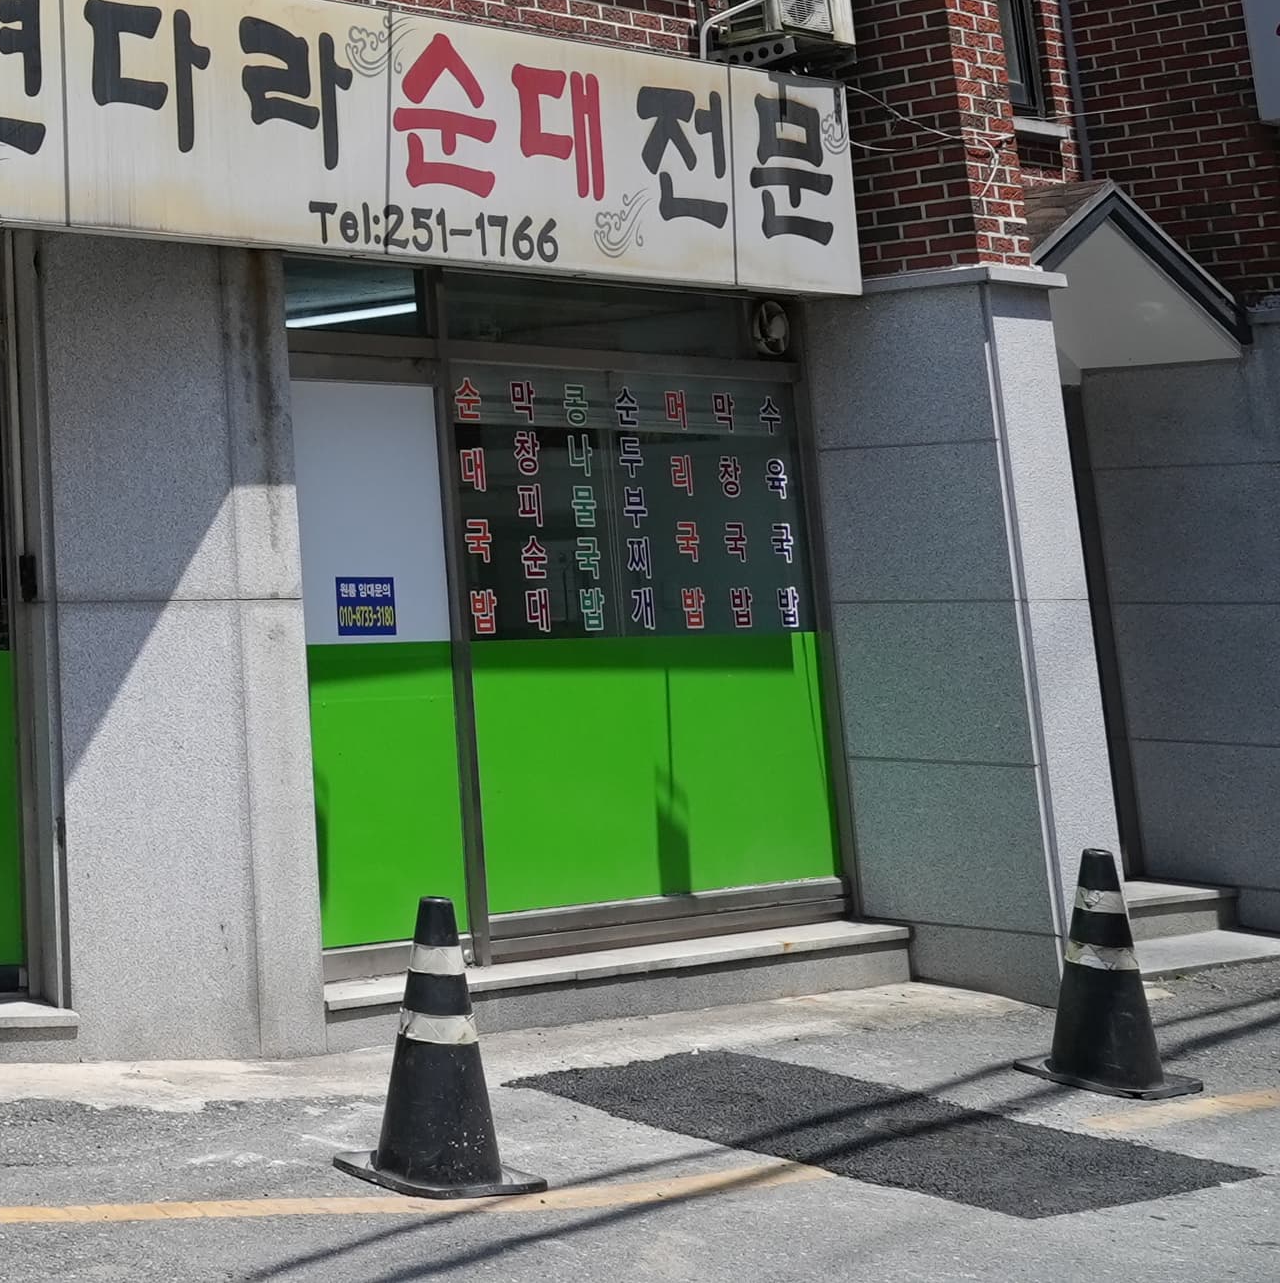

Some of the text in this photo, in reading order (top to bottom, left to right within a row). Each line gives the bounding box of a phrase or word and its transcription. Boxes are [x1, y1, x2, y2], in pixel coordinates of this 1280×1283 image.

[307, 199, 560, 264] Tel:251-1766
[453, 377, 497, 635] 순대국밥
[508, 379, 551, 632] 막창피순대
[563, 383, 605, 631] 콩나물국밥
[614, 386, 656, 630] 순두부찌개
[664, 390, 705, 629] 머리국밥
[711, 392, 753, 629] 막창국밥
[758, 396, 801, 629] 수육국밥
